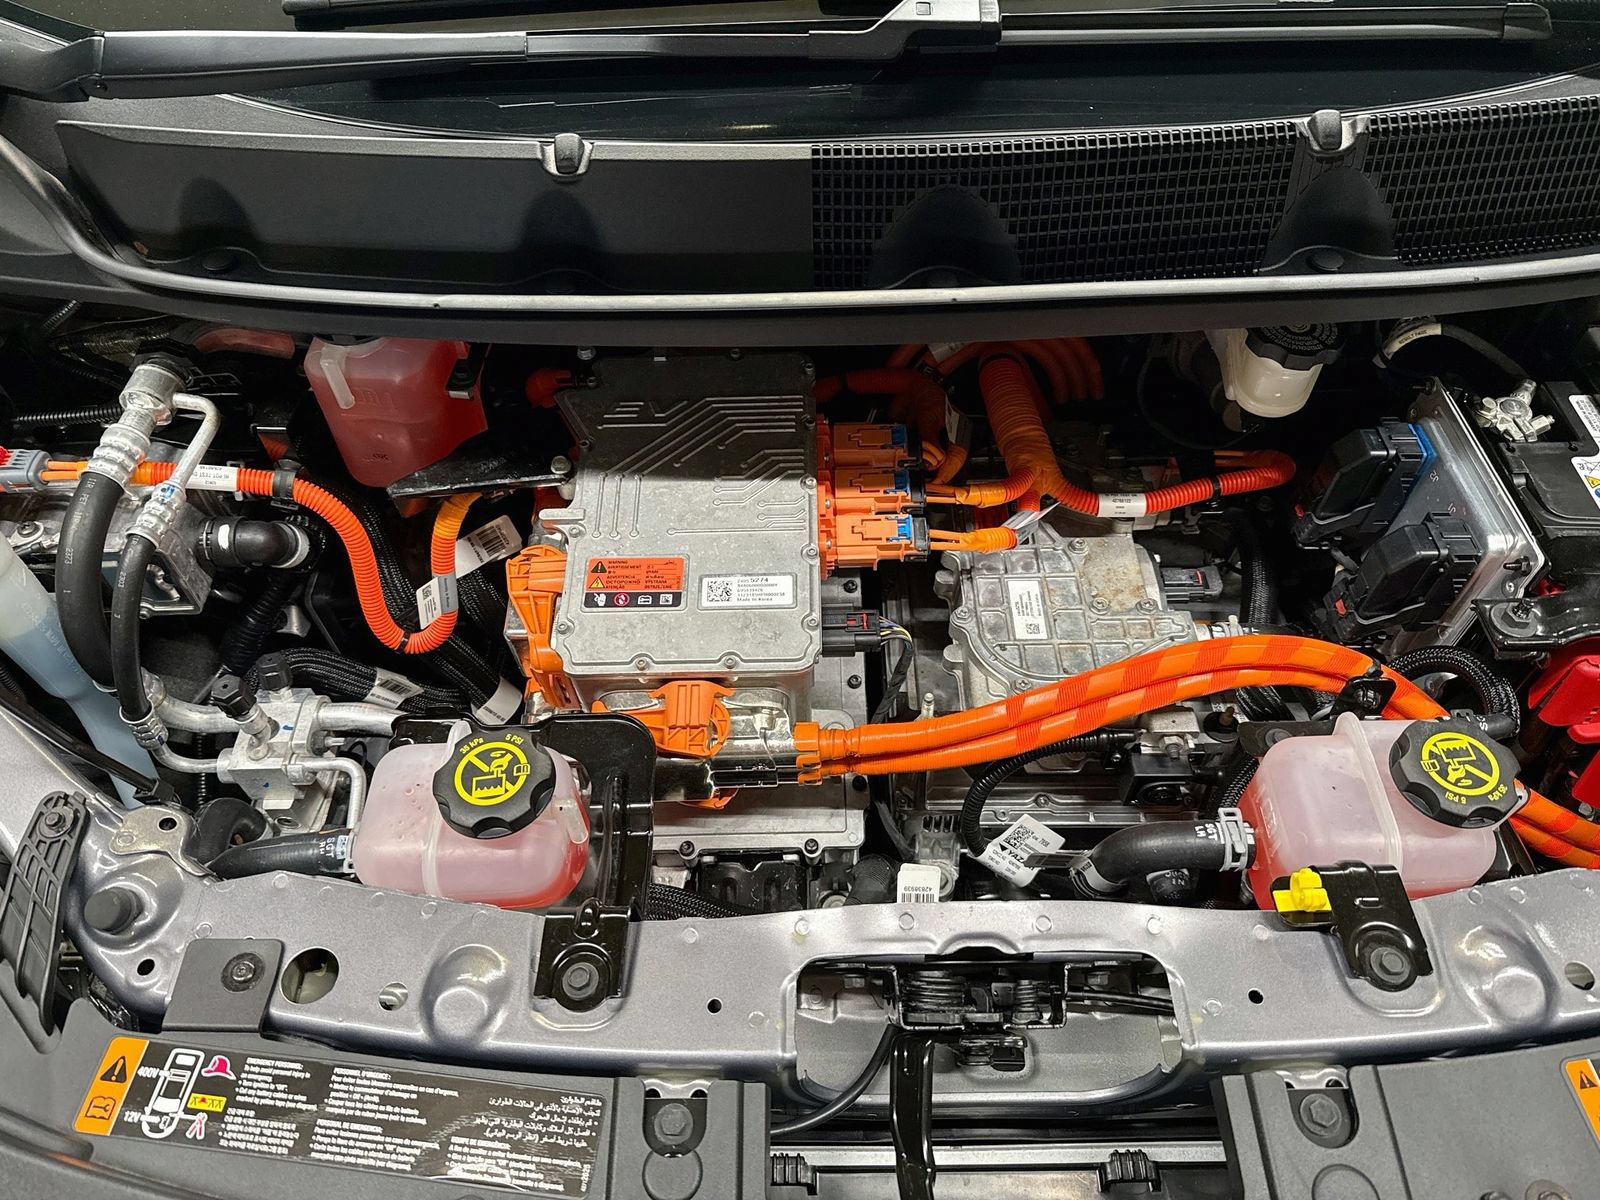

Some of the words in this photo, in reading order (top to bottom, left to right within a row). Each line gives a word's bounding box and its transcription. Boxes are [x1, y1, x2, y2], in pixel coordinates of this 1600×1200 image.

[459, 744, 470, 754] 35
[468, 737, 484, 748] kPa
[511, 735, 524, 745] PSI
[1445, 791, 1459, 802] PSI
[1195, 825, 1206, 837] LH
[1204, 823, 1218, 841] SGT
[325, 837, 336, 858] SGT
[137, 1066, 160, 1078] 400V
[124, 1110, 142, 1123] 12V
